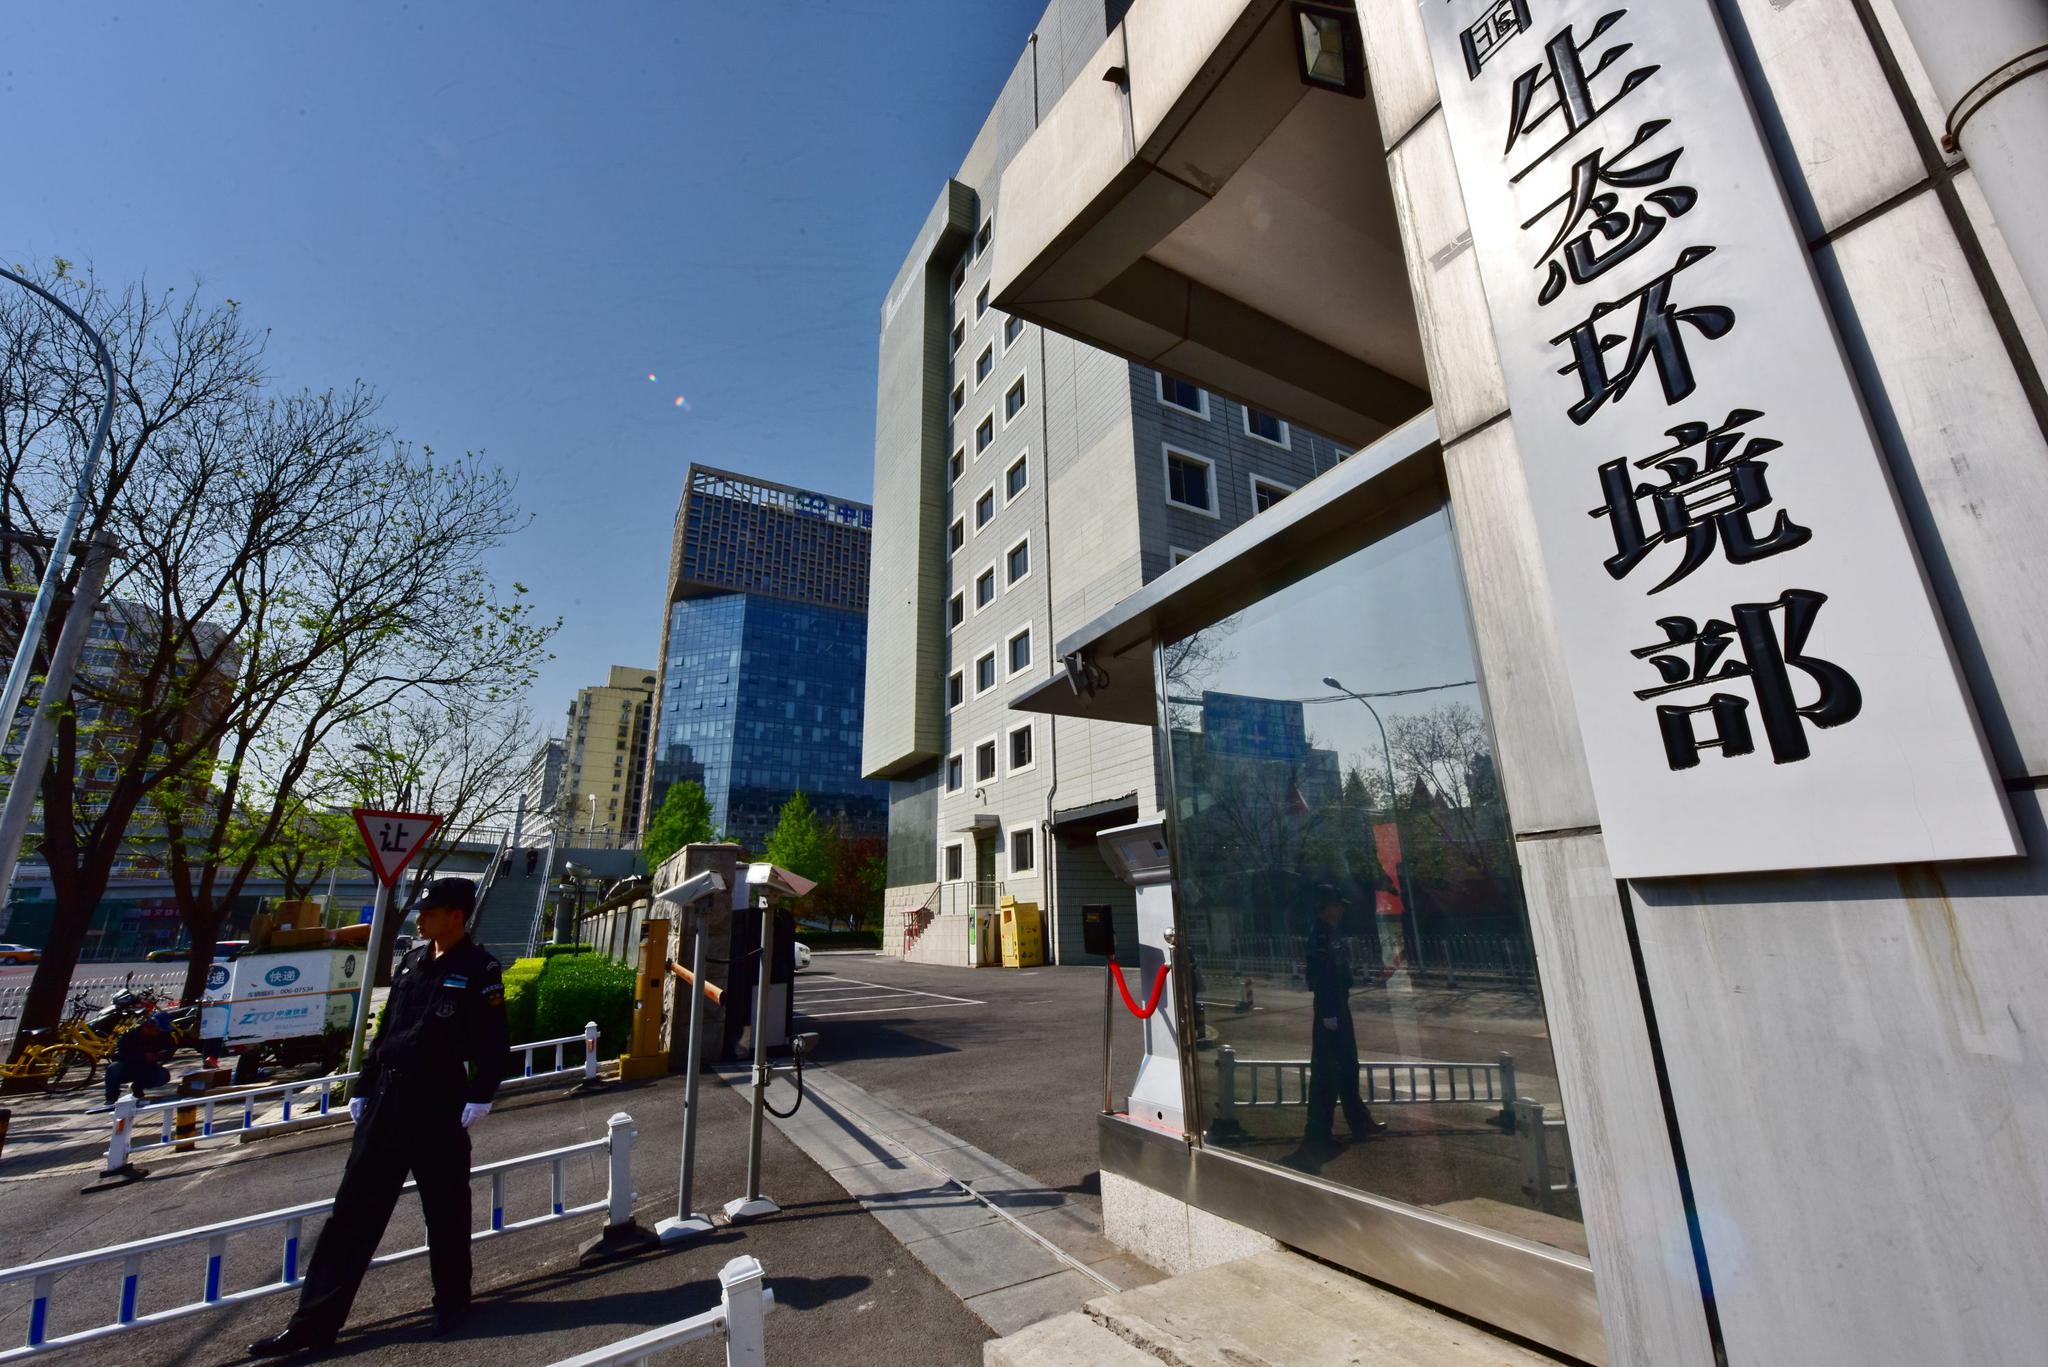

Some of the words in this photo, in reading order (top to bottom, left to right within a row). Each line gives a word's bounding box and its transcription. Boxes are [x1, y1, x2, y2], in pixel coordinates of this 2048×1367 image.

[1458, 0, 1862, 772] 国生态环境部
[379, 822, 409, 852] 让
[270, 970, 296, 983] 快递
[239, 1011, 275, 1025] ZTO
